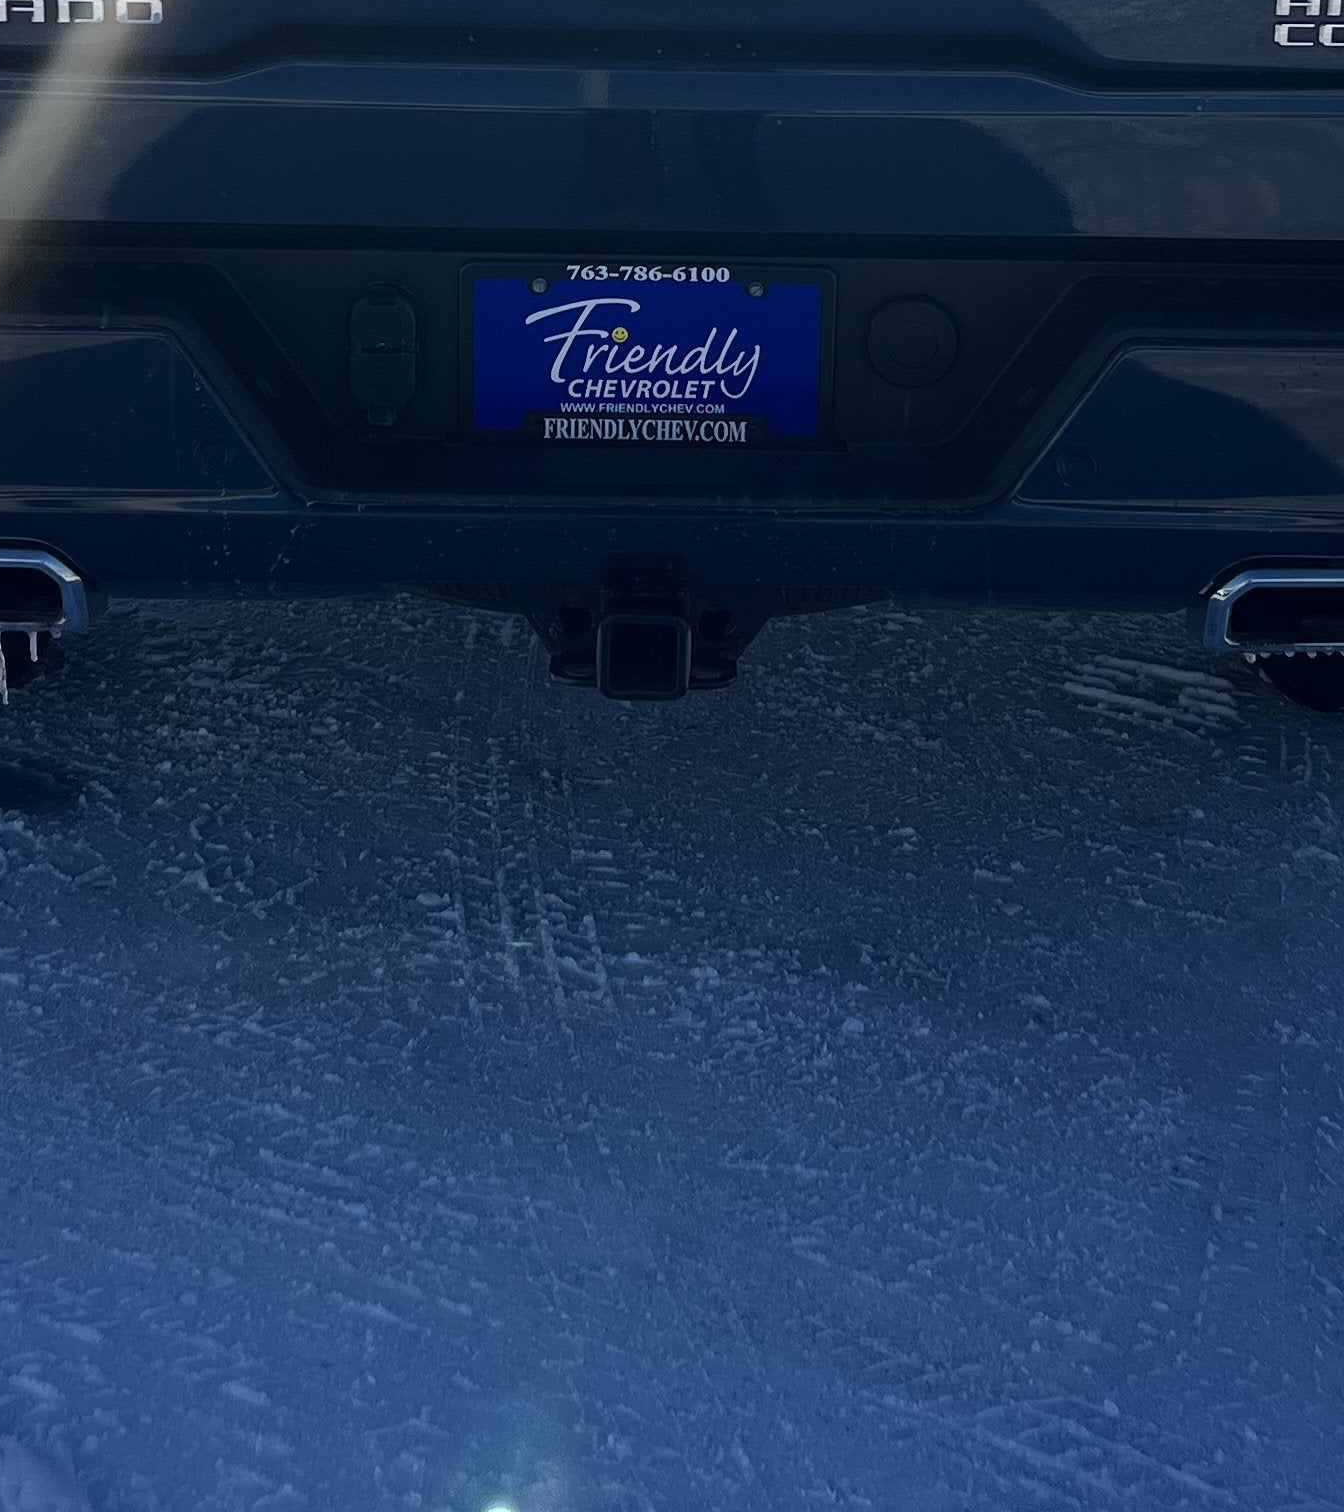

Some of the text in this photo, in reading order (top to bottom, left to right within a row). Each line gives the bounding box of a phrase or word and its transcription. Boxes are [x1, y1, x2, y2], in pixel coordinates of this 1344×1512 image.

[565, 264, 731, 283] 763-786-6100
[525, 297, 761, 400] Friendly
[567, 378, 717, 400] CHEVROLET
[560, 402, 726, 415] WWW.FRIENDLYCHEV.COM
[543, 417, 748, 443] FRIENDLYCHEV.COM
